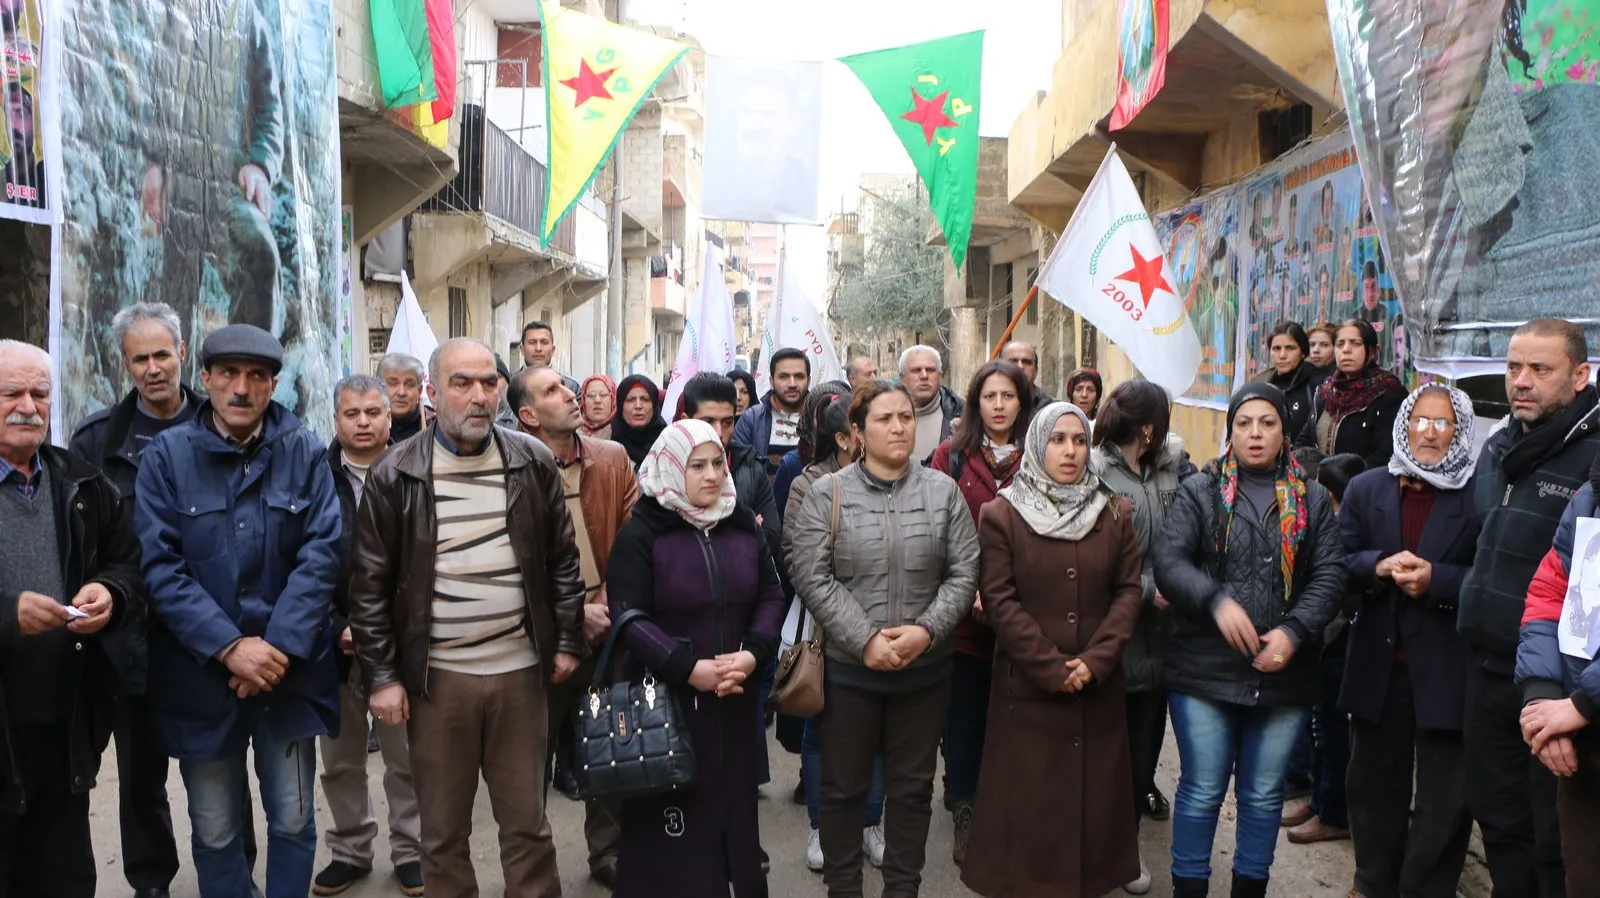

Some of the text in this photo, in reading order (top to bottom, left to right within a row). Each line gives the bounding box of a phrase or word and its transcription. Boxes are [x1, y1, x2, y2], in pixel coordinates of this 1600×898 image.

[1101, 283, 1143, 321] 2003
[805, 329, 823, 355] PYD
[664, 807, 685, 837] 3
